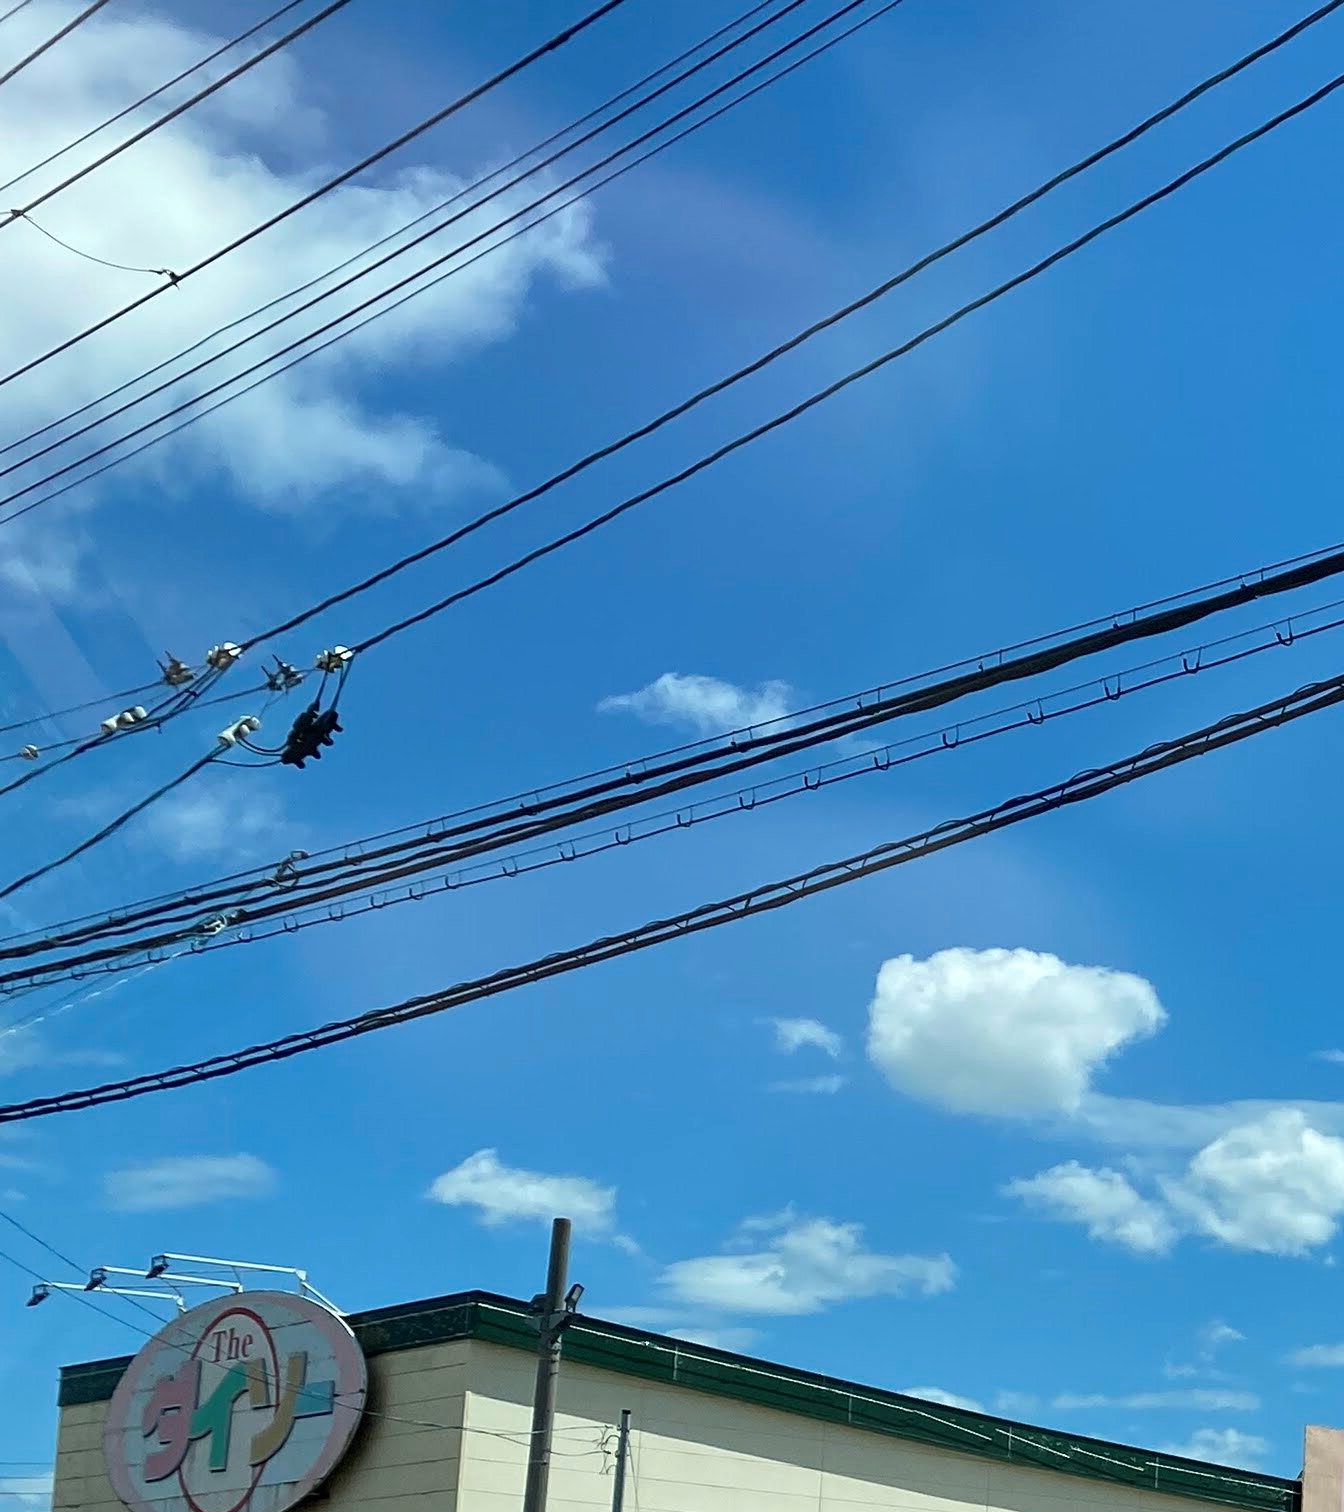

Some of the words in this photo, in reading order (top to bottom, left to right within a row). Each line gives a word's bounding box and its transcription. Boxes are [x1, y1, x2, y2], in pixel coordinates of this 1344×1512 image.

[212, 1328, 254, 1364] The
[143, 1352, 335, 1483] ダイソー
